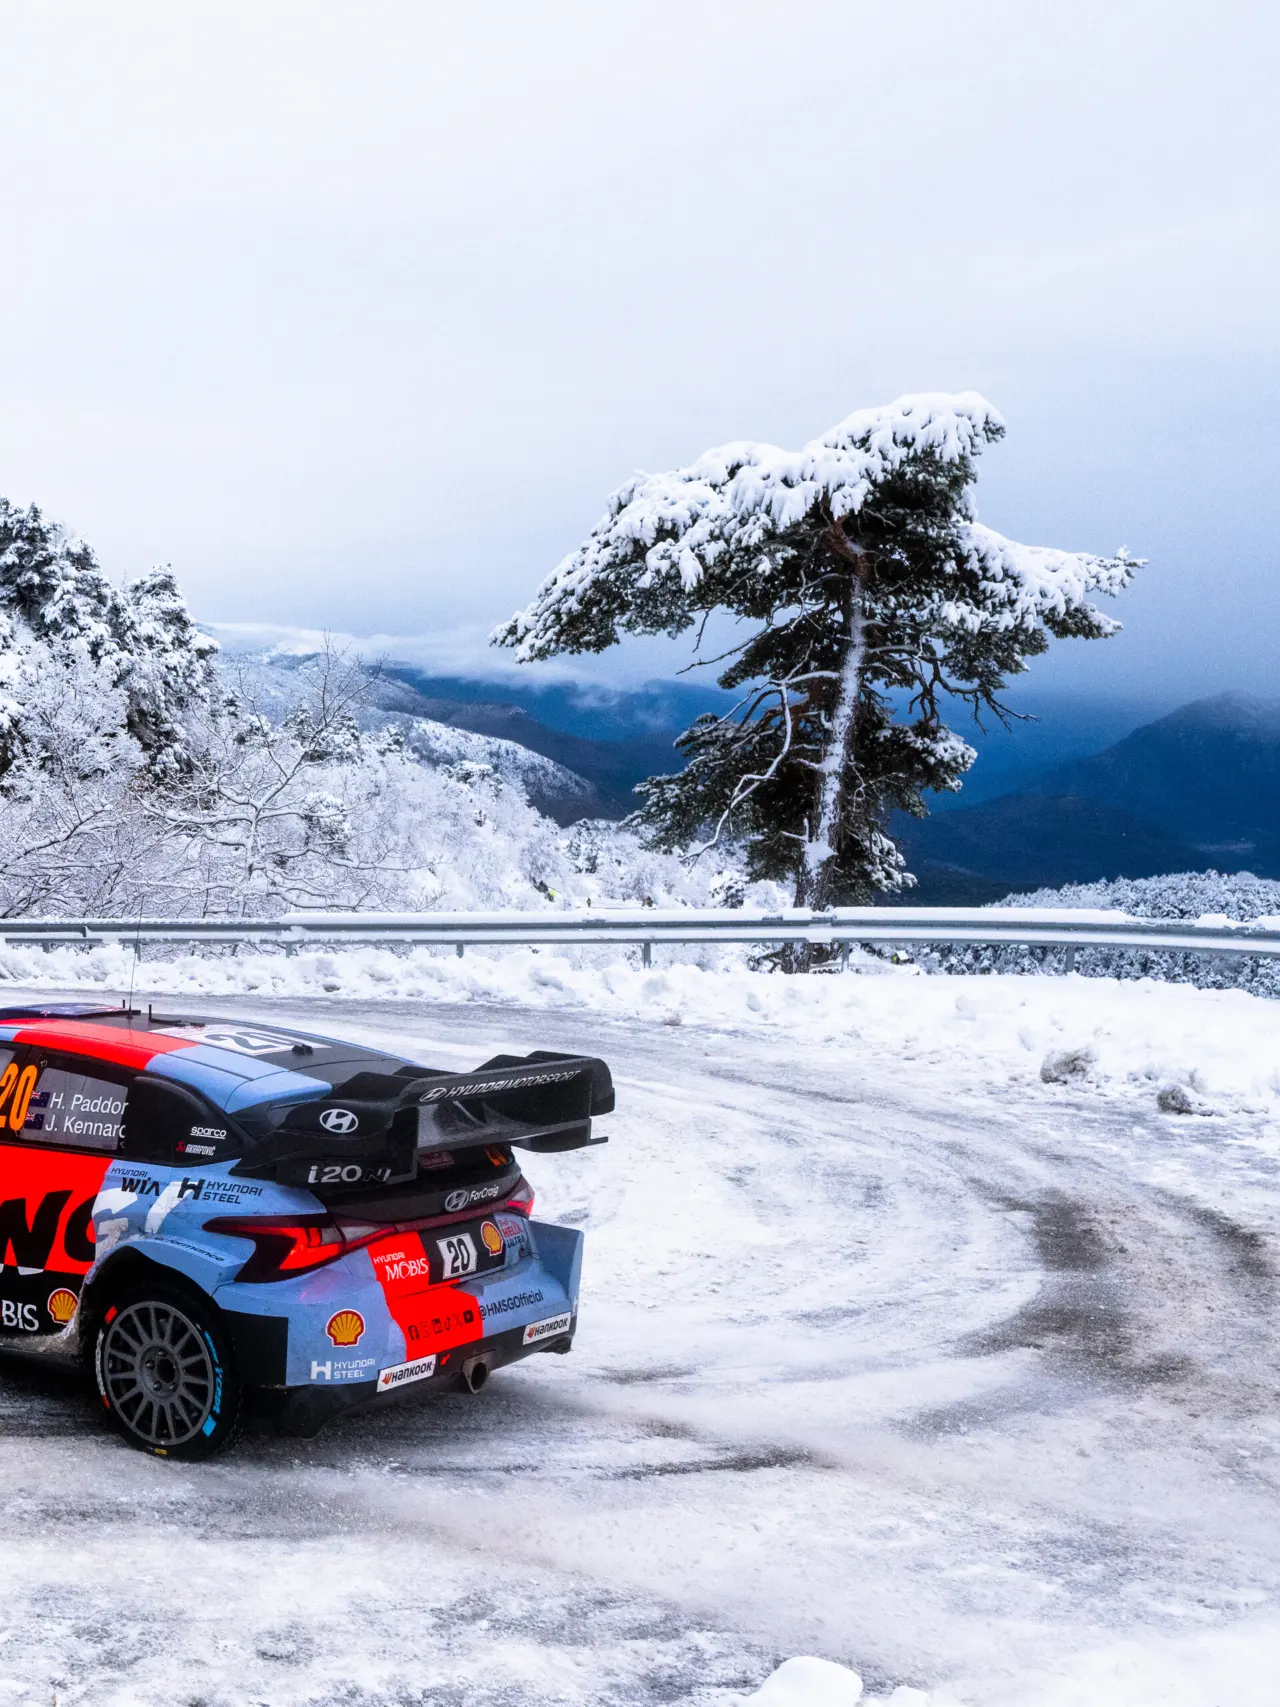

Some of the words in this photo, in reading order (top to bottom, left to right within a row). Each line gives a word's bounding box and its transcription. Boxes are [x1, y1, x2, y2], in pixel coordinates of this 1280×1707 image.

[49, 1092, 65, 1110] H.
[45, 1114, 58, 1132] J.
[190, 1126, 227, 1139] sparco
[110, 1167, 148, 1178] HYUNDAI
[307, 1165, 362, 1184] i20
[121, 1176, 160, 1197] WIA
[206, 1180, 263, 1197] HYUNDAI
[202, 1191, 241, 1205] STEEL
[373, 1251, 405, 1264] HYUNDAI
[446, 1237, 470, 1274] 20
[385, 1257, 429, 1281] MOBIS
[478, 1289, 544, 1320] @HMSGOfficial
[334, 1358, 376, 1370] HYUNDAI
[334, 1369, 365, 1379] STEEL
